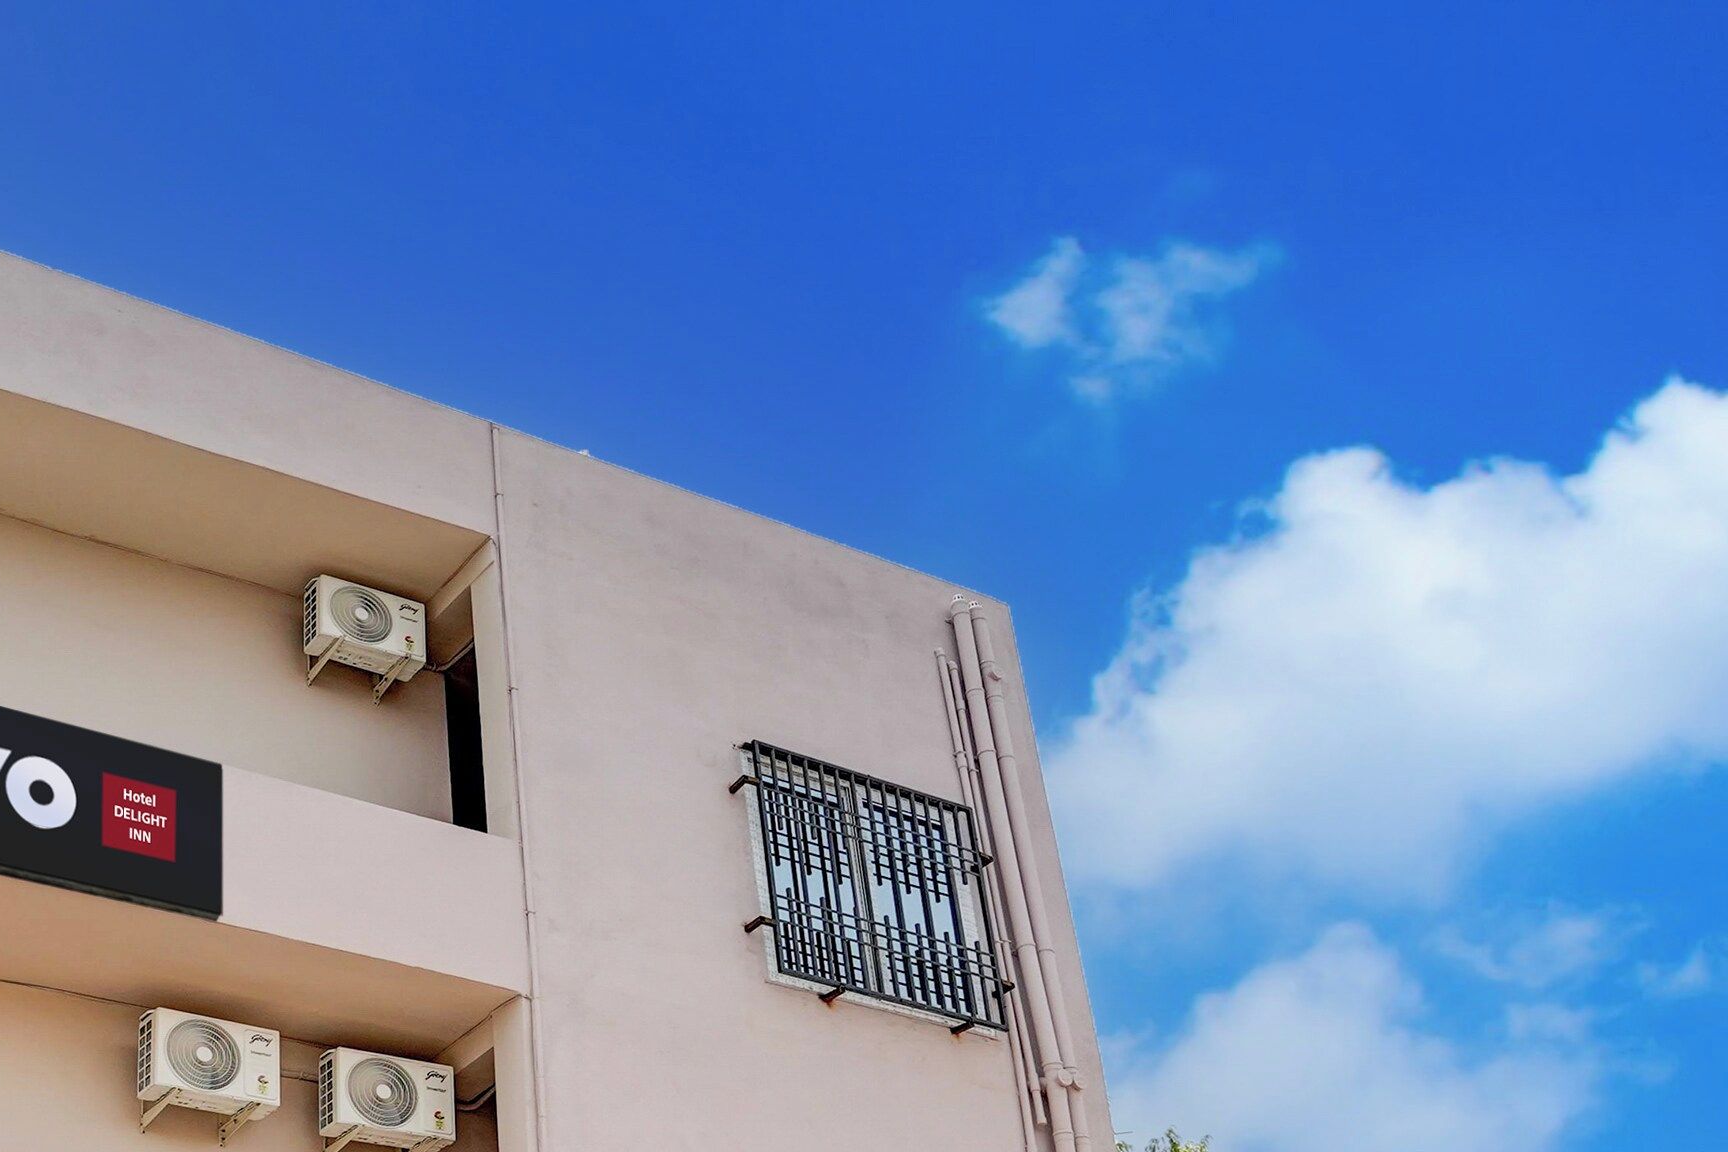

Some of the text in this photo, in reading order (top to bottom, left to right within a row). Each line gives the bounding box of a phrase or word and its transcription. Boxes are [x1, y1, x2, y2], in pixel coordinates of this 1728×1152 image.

[123, 788, 156, 807] Hotel
[114, 804, 168, 828] DELIGHT
[129, 827, 151, 844] INN
